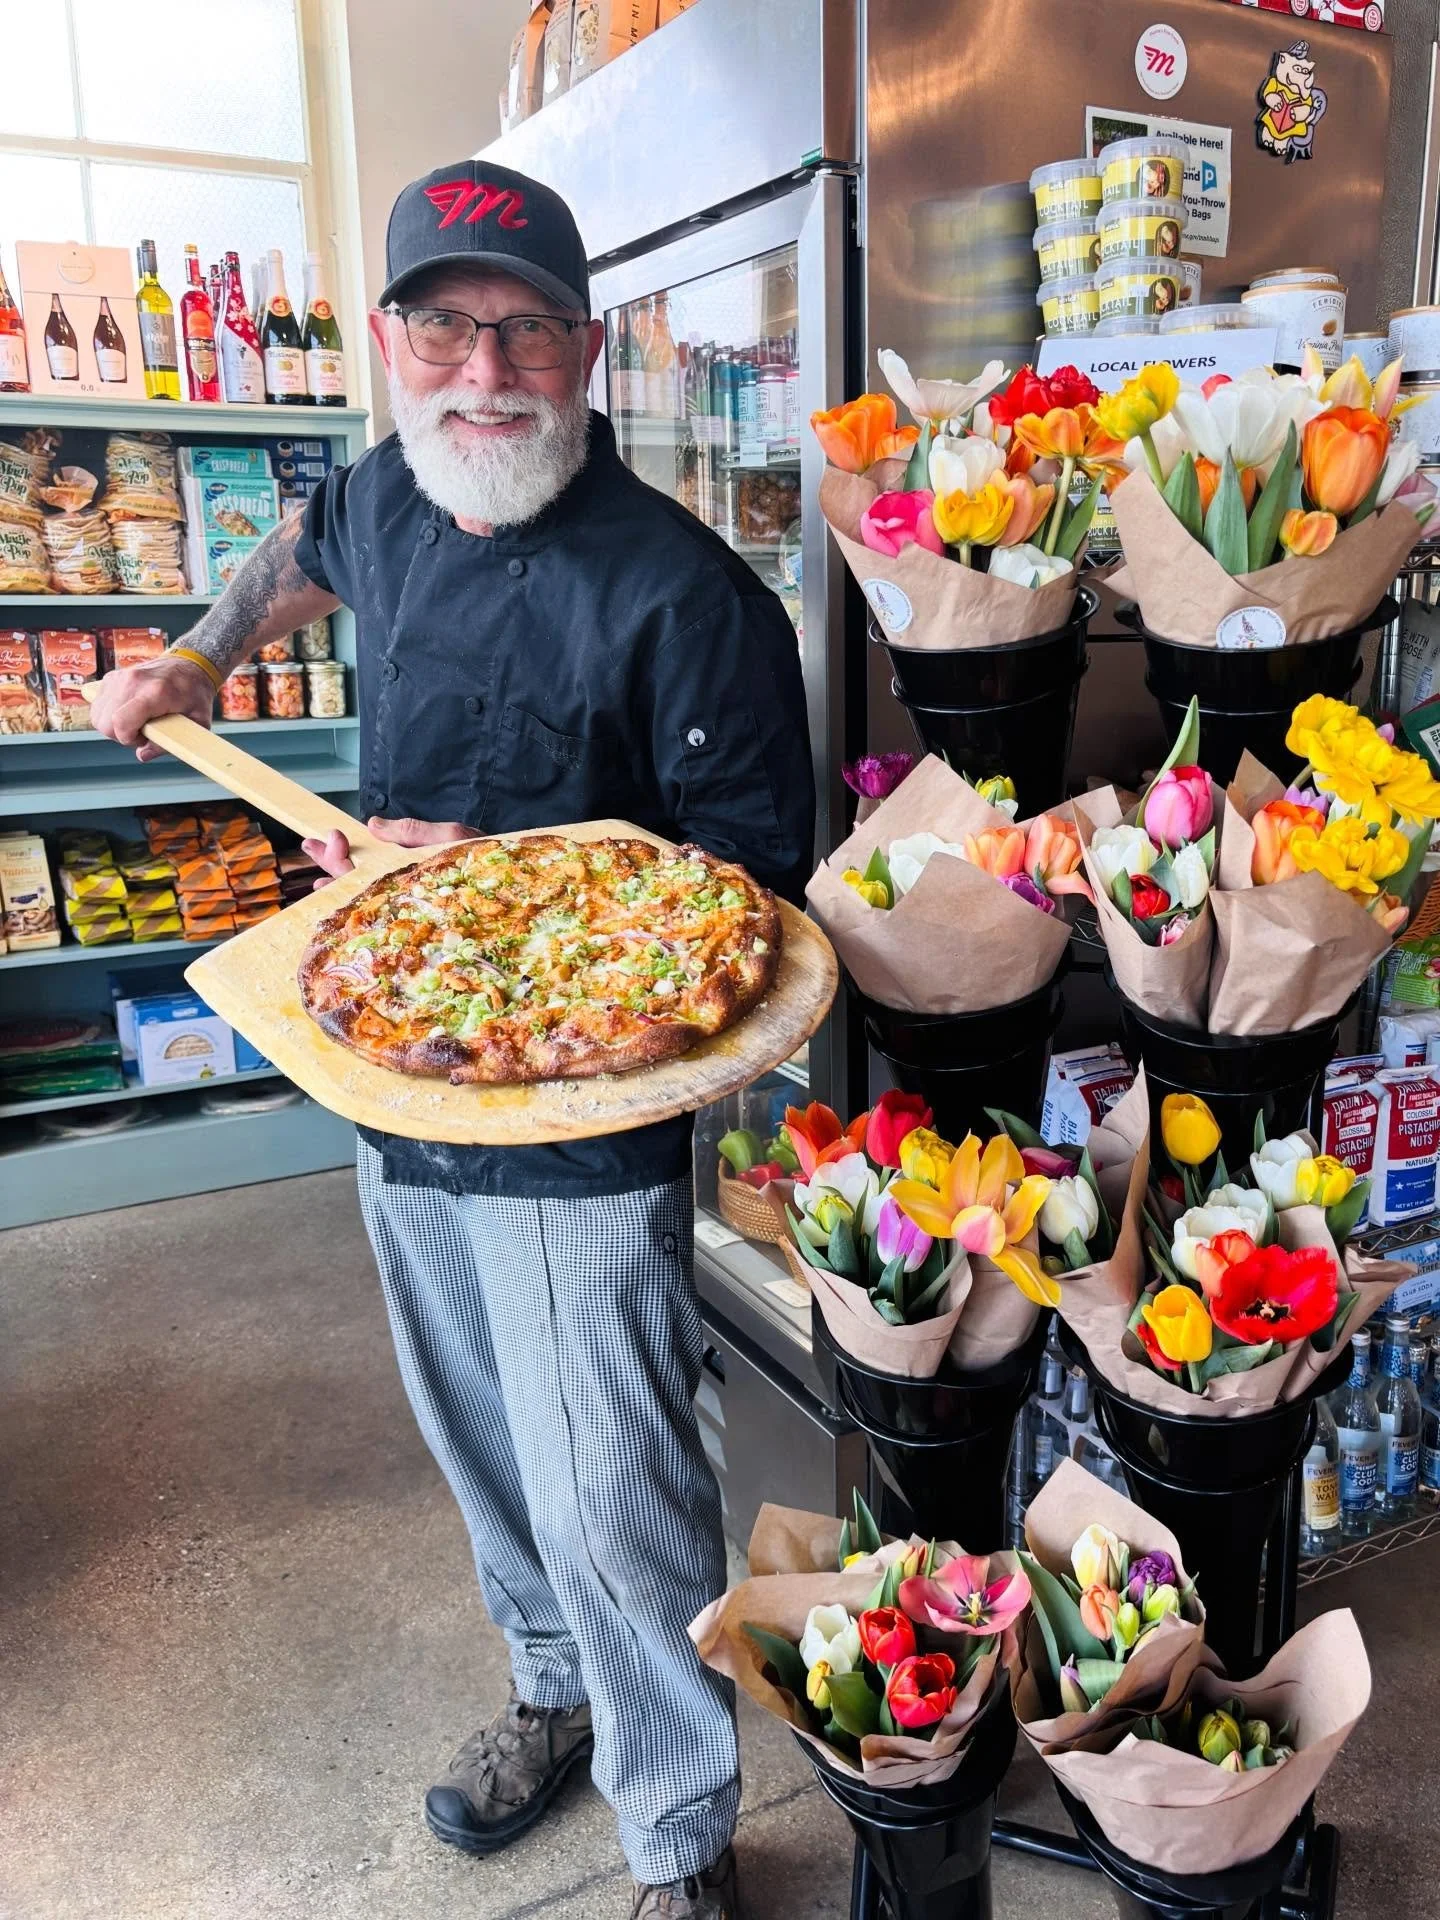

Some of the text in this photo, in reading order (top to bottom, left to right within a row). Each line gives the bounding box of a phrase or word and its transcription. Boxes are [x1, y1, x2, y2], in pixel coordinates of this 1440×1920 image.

[1200, 137, 1223, 150] Here!
[1039, 200, 1088, 217] COCKTAIL
[1192, 209, 1211, 221] Bags
[1048, 312, 1098, 329] COCKTAIL
[1090, 361, 1138, 373] LOCAL
[126, 470, 149, 485] Pop
[1, 477, 27, 496] Pop
[4, 546, 31, 560] Pop
[123, 569, 143, 584] Pop
[1409, 631, 1430, 648] WITH
[1406, 1110, 1433, 1119] COLOSSAL
[1341, 1126, 1366, 1137] COLOSSAL
[1335, 1136, 1374, 1155] PISTACHIO
[1410, 1134, 1433, 1148] NUTS
[1344, 1152, 1367, 1167] NUTS
[1406, 1156, 1433, 1167] NATURAL
